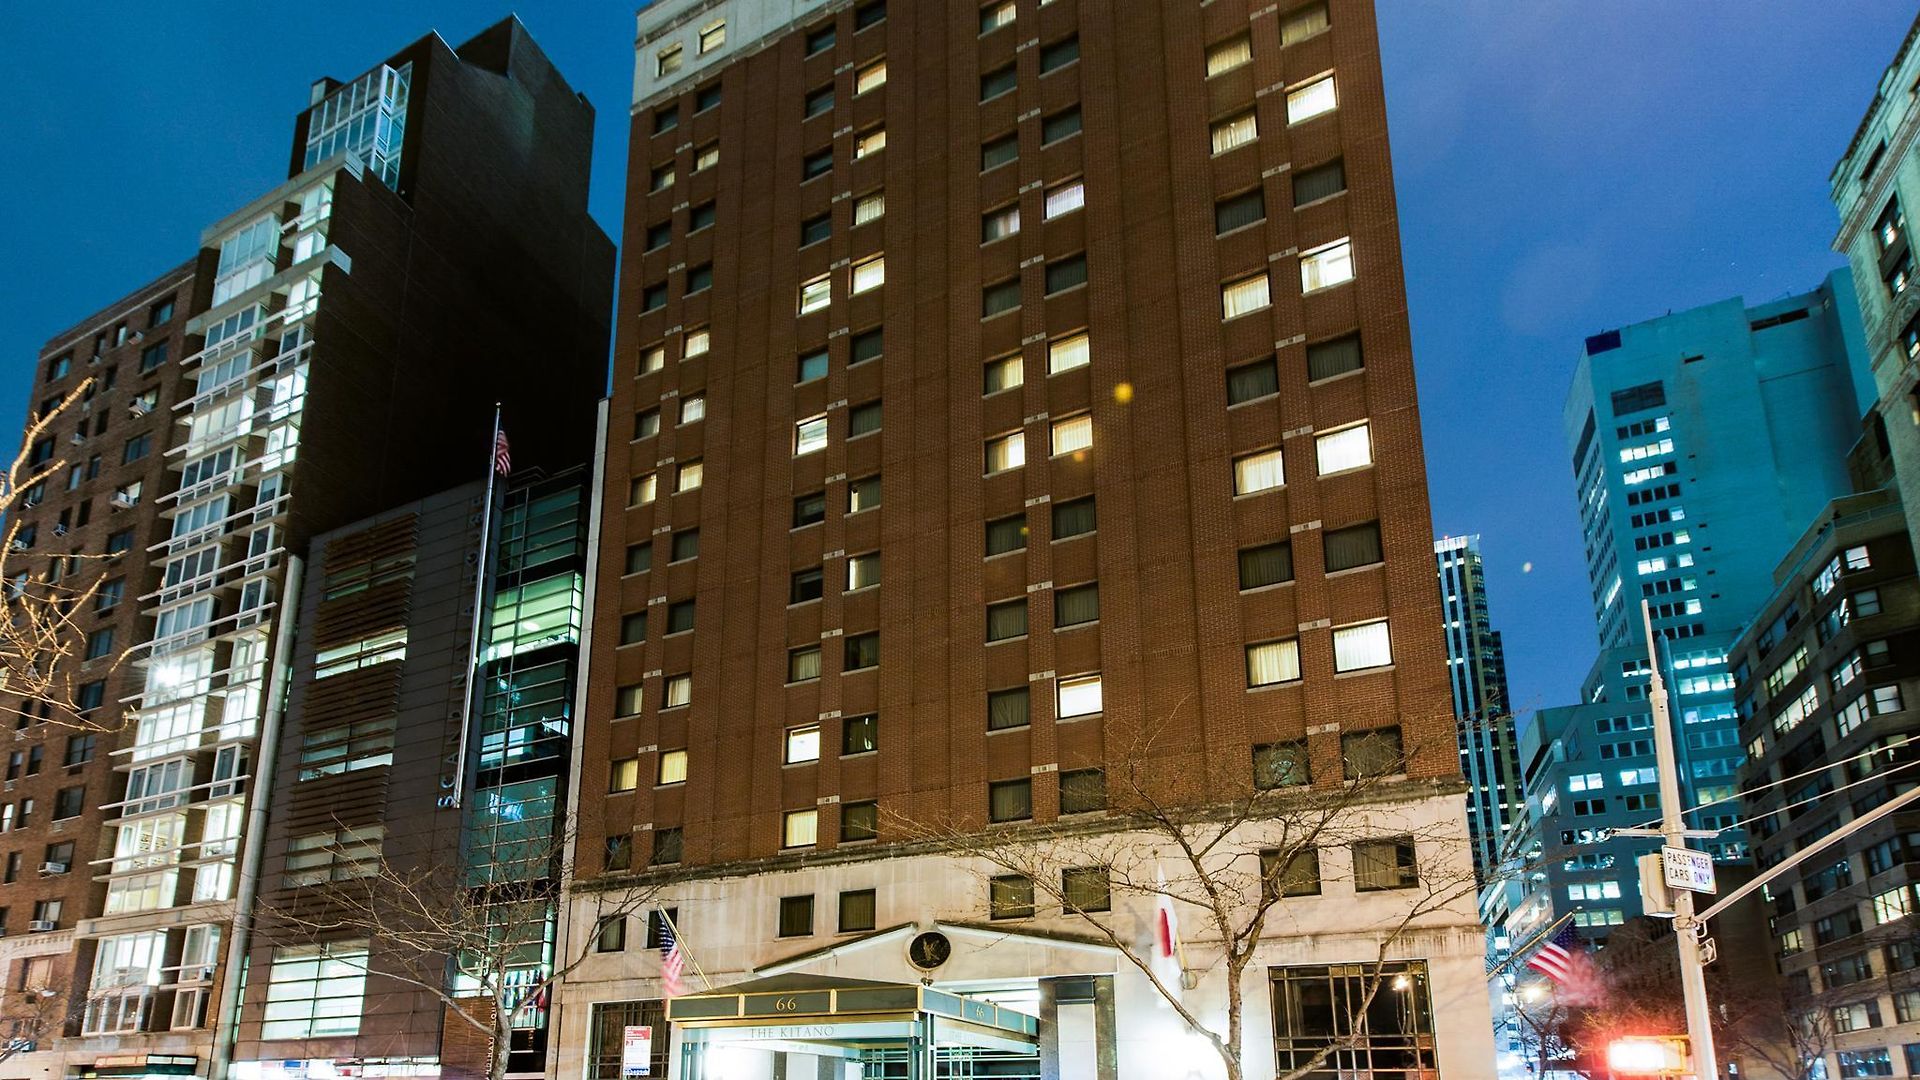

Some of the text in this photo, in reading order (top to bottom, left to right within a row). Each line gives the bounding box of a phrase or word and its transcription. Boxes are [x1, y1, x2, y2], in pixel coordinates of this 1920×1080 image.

[436, 606, 474, 809] SCANDINAVA
[1667, 852, 1710, 869] PASSENGER
[1670, 868, 1711, 884] CARS ONLY
[776, 997, 796, 1011] 66
[976, 1005, 985, 1018] 66
[751, 1026, 835, 1038] THE KITANO
